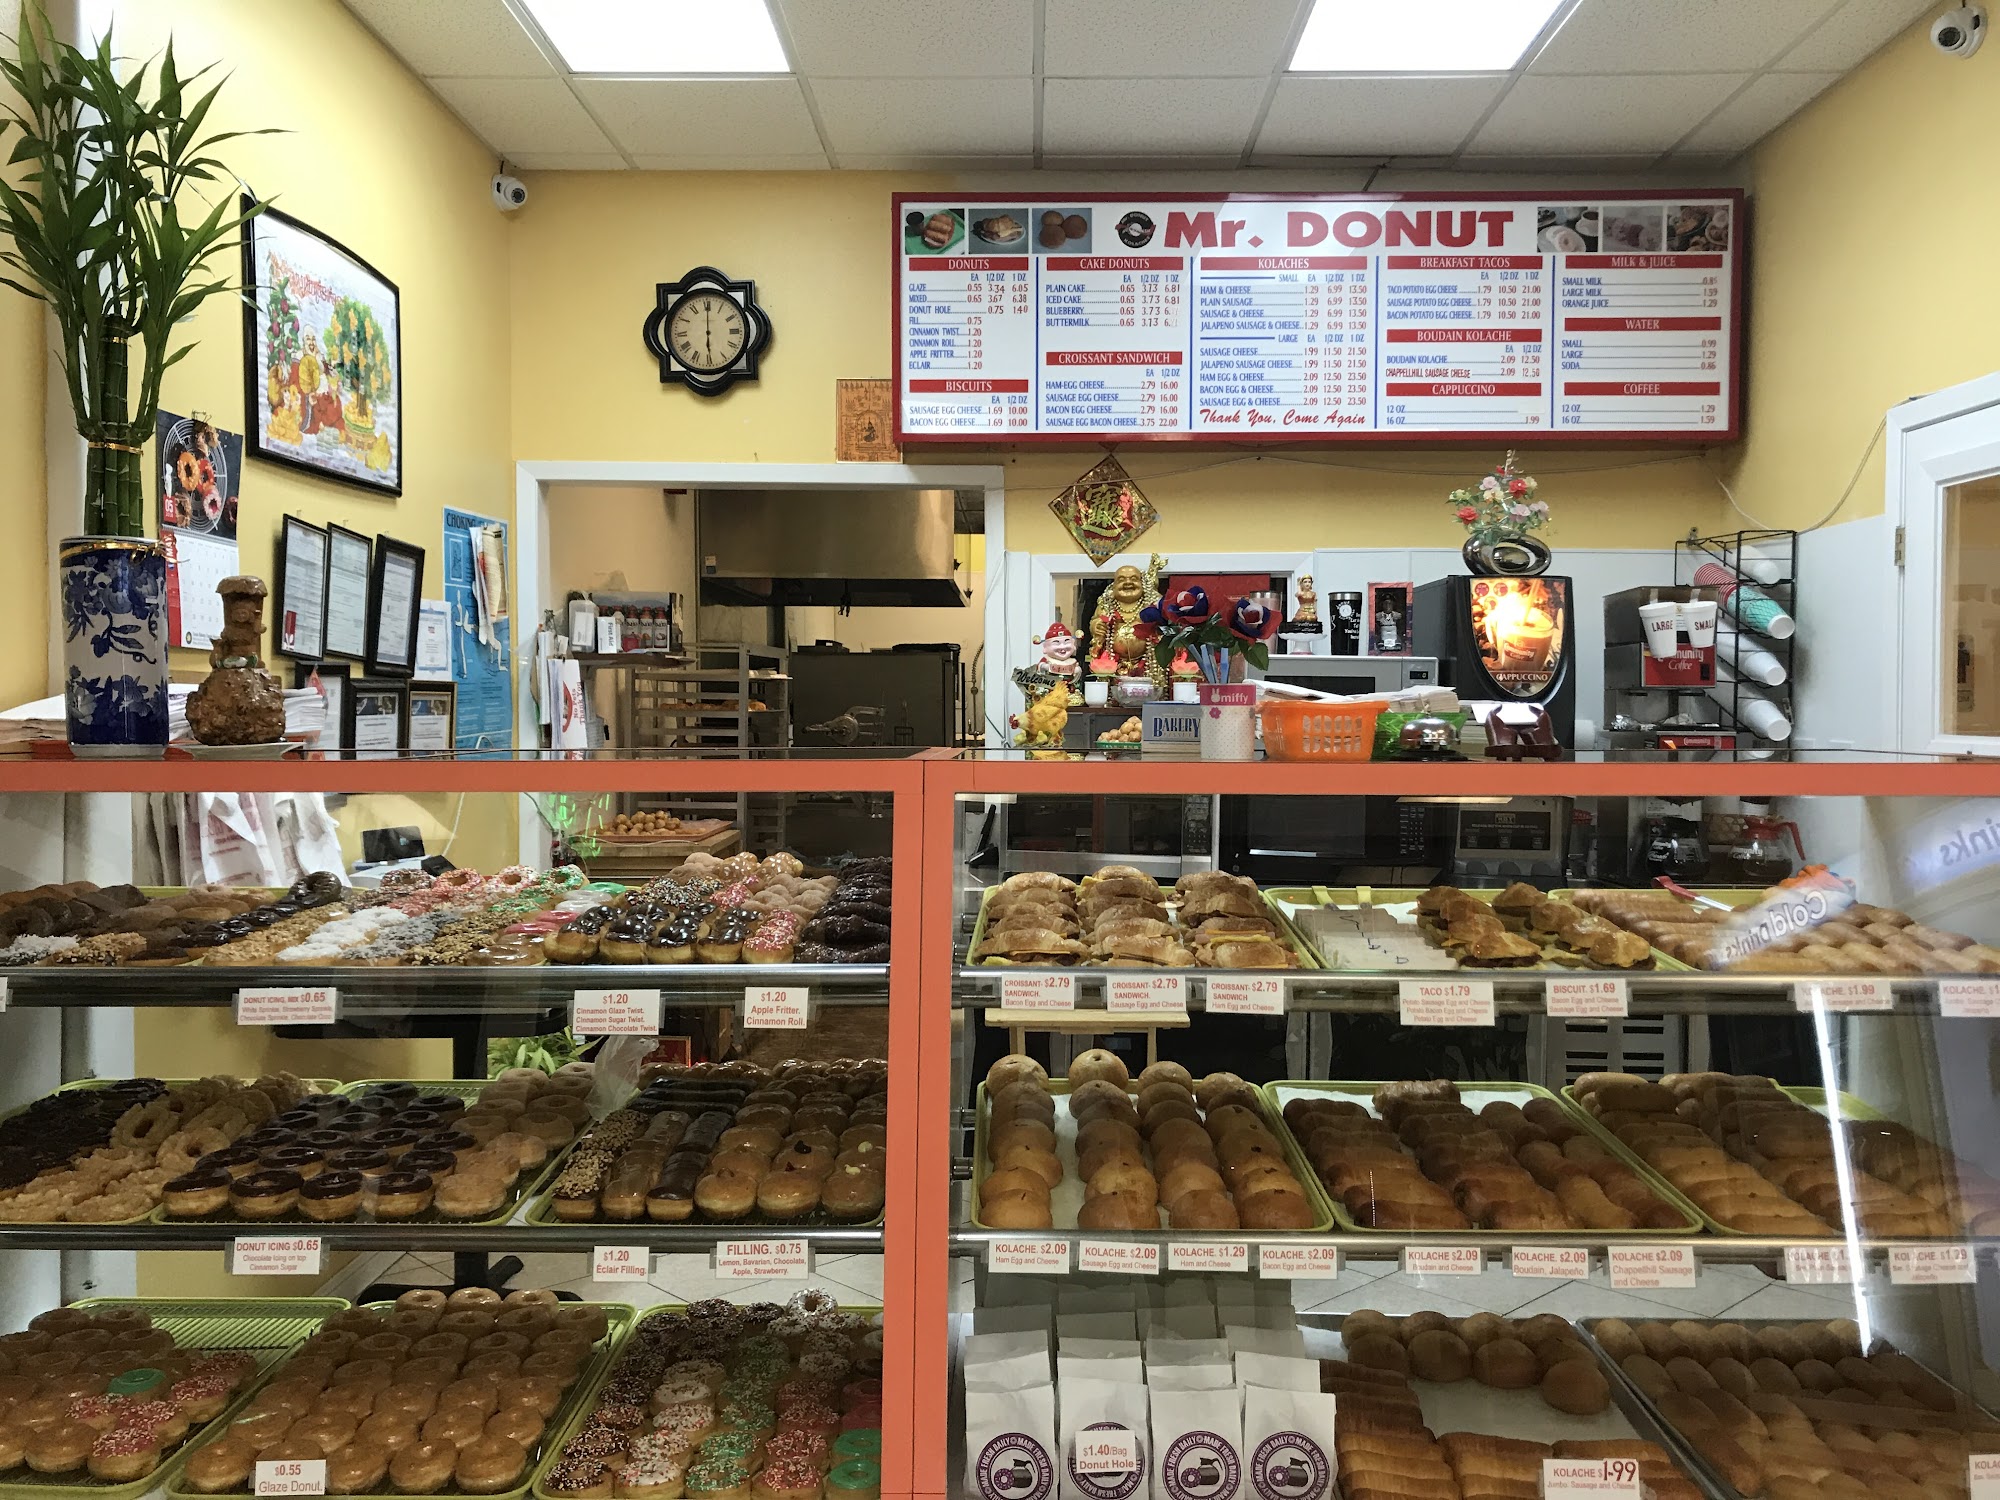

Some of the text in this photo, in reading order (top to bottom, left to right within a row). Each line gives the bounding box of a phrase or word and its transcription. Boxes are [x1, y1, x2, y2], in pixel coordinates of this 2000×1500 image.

[1164, 212, 1264, 248] Mr.
[1287, 211, 1514, 248] DONUT
[948, 259, 990, 270] DONUTS
[1080, 258, 1150, 270] CAKE DONUTS
[1258, 258, 1309, 269] KOLACHES
[1420, 257, 1511, 269] BREAKFAST TACOS
[1611, 256, 1676, 269] MILK & JUICE
[908, 283, 1029, 294] GLAZE 0.55 3.34 6.05
[908, 294, 1027, 303] MIXED 0.65 3.67 6.38
[1046, 295, 1180, 305] ICED CAKE 0.65 3.73 6.81
[1562, 299, 1717, 309] ORANGE JUICE 1.29
[908, 316, 982, 326] FILL 0.75
[1625, 319, 1660, 330] WATER
[909, 327, 982, 336] CINNAMON TWIST 1.20
[1417, 330, 1512, 342] BOUDAIN KOLACHE
[909, 349, 983, 359] APPLE FRITTER 1.20
[1200, 347, 1366, 357] SAUSAGE CHEESE 1.99 11.50 21.50
[1058, 353, 1170, 364] CROISSANT SANDWICH
[1386, 355, 1540, 364] BOUDAIN KOLACHE 2.09 12.50
[908, 361, 983, 370] ECLAIR 1.20
[1561, 361, 1581, 370] SODA
[1200, 372, 1366, 381] HAM EGG & CHEESE 2.09 12.50 23.50
[945, 381, 992, 392] BISCUITS
[1046, 381, 1178, 390] HAM-EGG CHEESE 2.79 16.00
[1431, 384, 1496, 395] CAPPUCCINO
[1623, 383, 1660, 395] COFFEE
[909, 418, 1028, 427] BACON EGG CHEESE 1.69 10.00
[1199, 408, 1365, 428] Thank You, Come Again
[446, 513, 475, 530] CHOKING
[165, 534, 174, 557] MAY
[1651, 620, 1673, 633] LARGE
[1694, 618, 1715, 631] SMALL
[1668, 660, 1693, 671] Coffee
[1016, 671, 1056, 687] Welcome
[1496, 673, 1548, 681] CAPPUCCINO
[1221, 693, 1249, 704] miffy
[1153, 717, 1201, 737] BAKERY
[1683, 737, 1711, 746] Community
[1004, 977, 1070, 988] CROISSANT- $2.79
[1211, 981, 1278, 992] CROISSANT- $2.79
[1590, 983, 1615, 993] $1.69
[1420, 985, 1470, 996] TACO $1.79
[603, 993, 628, 1005] $1.20
[761, 991, 786, 1002] $1.20
[751, 1005, 801, 1015] Apple Fritter.
[746, 1017, 805, 1026] Cinnamon Roll.
[236, 1240, 318, 1251] DONUT ICING $0.65
[727, 1243, 801, 1255] FILLING. $0.75
[1040, 1243, 1067, 1254] $2.09
[603, 1250, 629, 1261] $1.20
[1219, 1246, 1245, 1257] $1.29
[1612, 1250, 1683, 1262] KOLACHE $2.09
[243, 1254, 272, 1262] Chocolate
[273, 1254, 287, 1262] Icing
[297, 1254, 307, 1262] top
[1010, 1257, 1023, 1265] Egg
[596, 1263, 647, 1276] Éclair Filling.
[1659, 1266, 1692, 1276] Sausage
[1614, 1278, 1660, 1286] and Cheese
[1083, 1444, 1127, 1457] $1.40/Bag
[980, 1437, 1010, 1487] MADE FRESH DAILY
[1255, 1436, 1288, 1482] MADE FRESH DAILY
[275, 1464, 301, 1476] $0.55
[1080, 1460, 1134, 1470] Donut Hole
[1553, 1468, 1596, 1478] KOLACHE
[259, 1480, 323, 1493] Glaze Donut.
